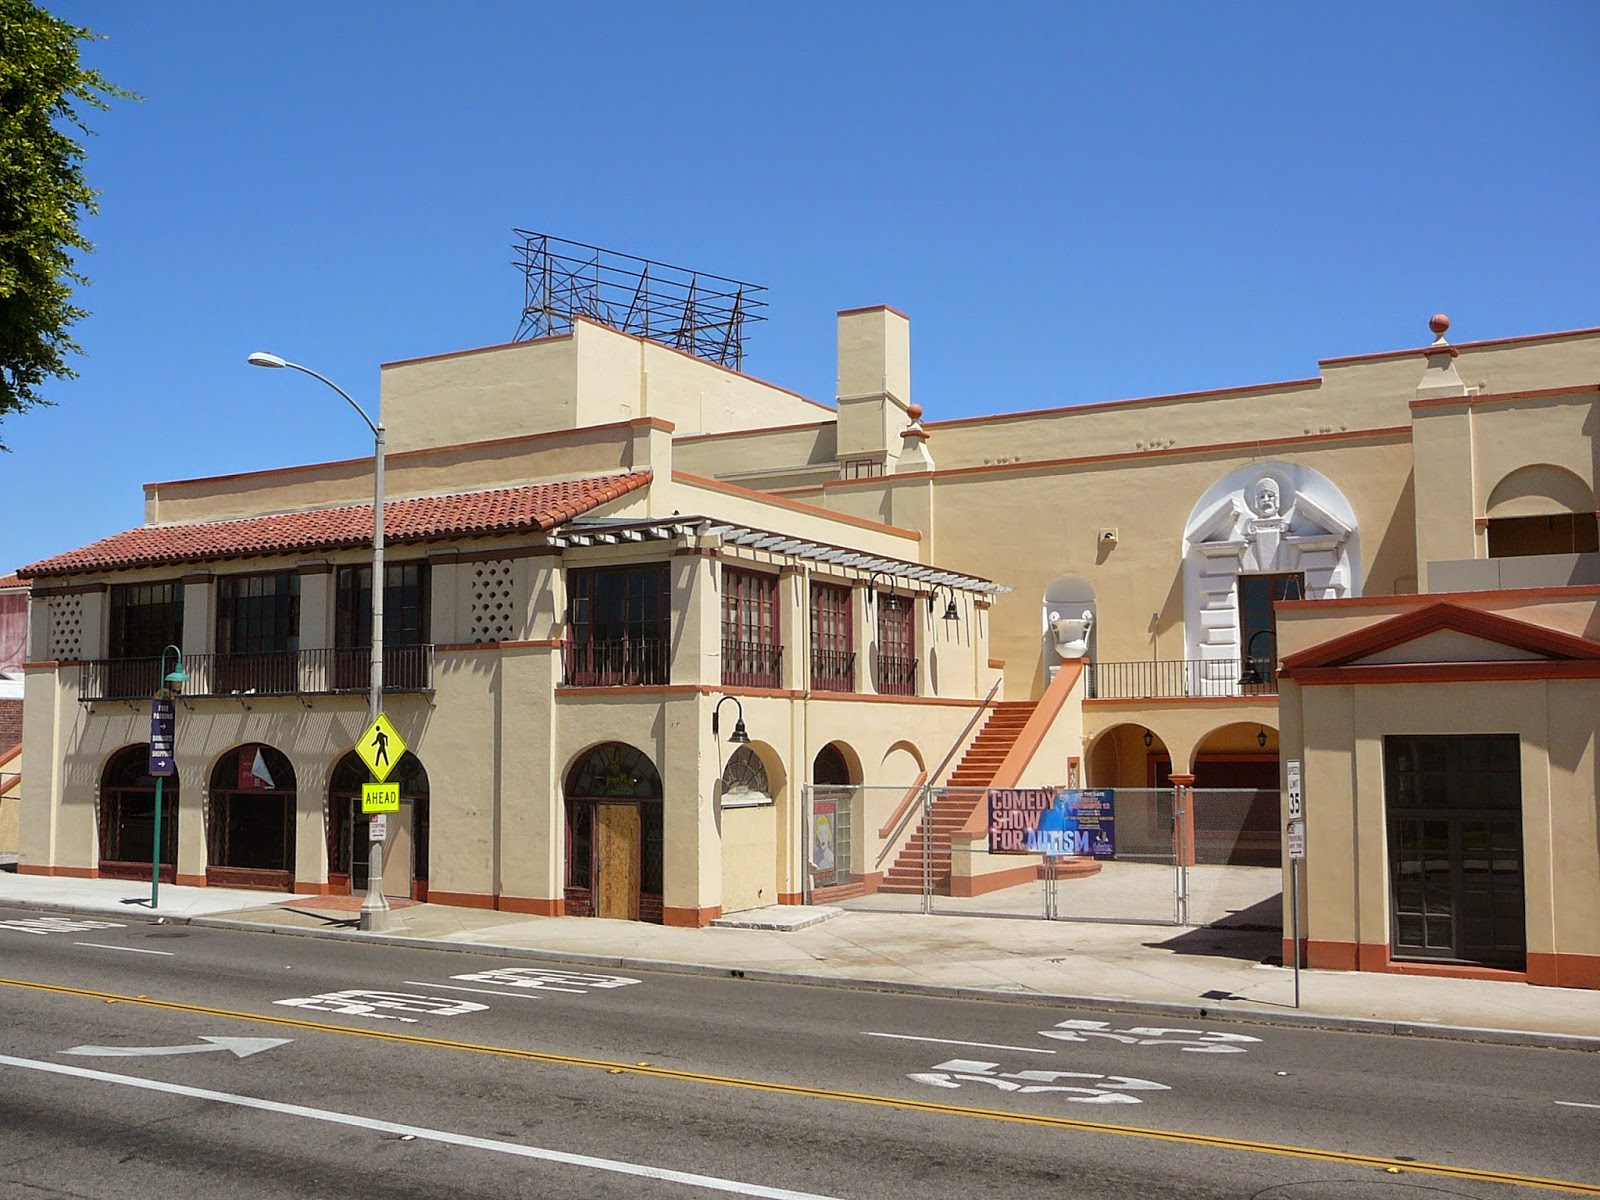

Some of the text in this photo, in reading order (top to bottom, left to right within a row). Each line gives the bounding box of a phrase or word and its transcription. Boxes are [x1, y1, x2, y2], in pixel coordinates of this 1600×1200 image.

[153, 712, 173, 720] PARKING
[1289, 779, 1299, 789] LIMIT
[366, 791, 396, 805] AHEAD
[992, 790, 1056, 810] COMEDY
[1289, 792, 1300, 814] 35
[992, 810, 1042, 830] SHOW
[992, 830, 1025, 850] FOR
[1026, 830, 1089, 853] AUTISM
[1037, 1018, 1264, 1053] 35
[905, 1058, 1173, 1105] 35
